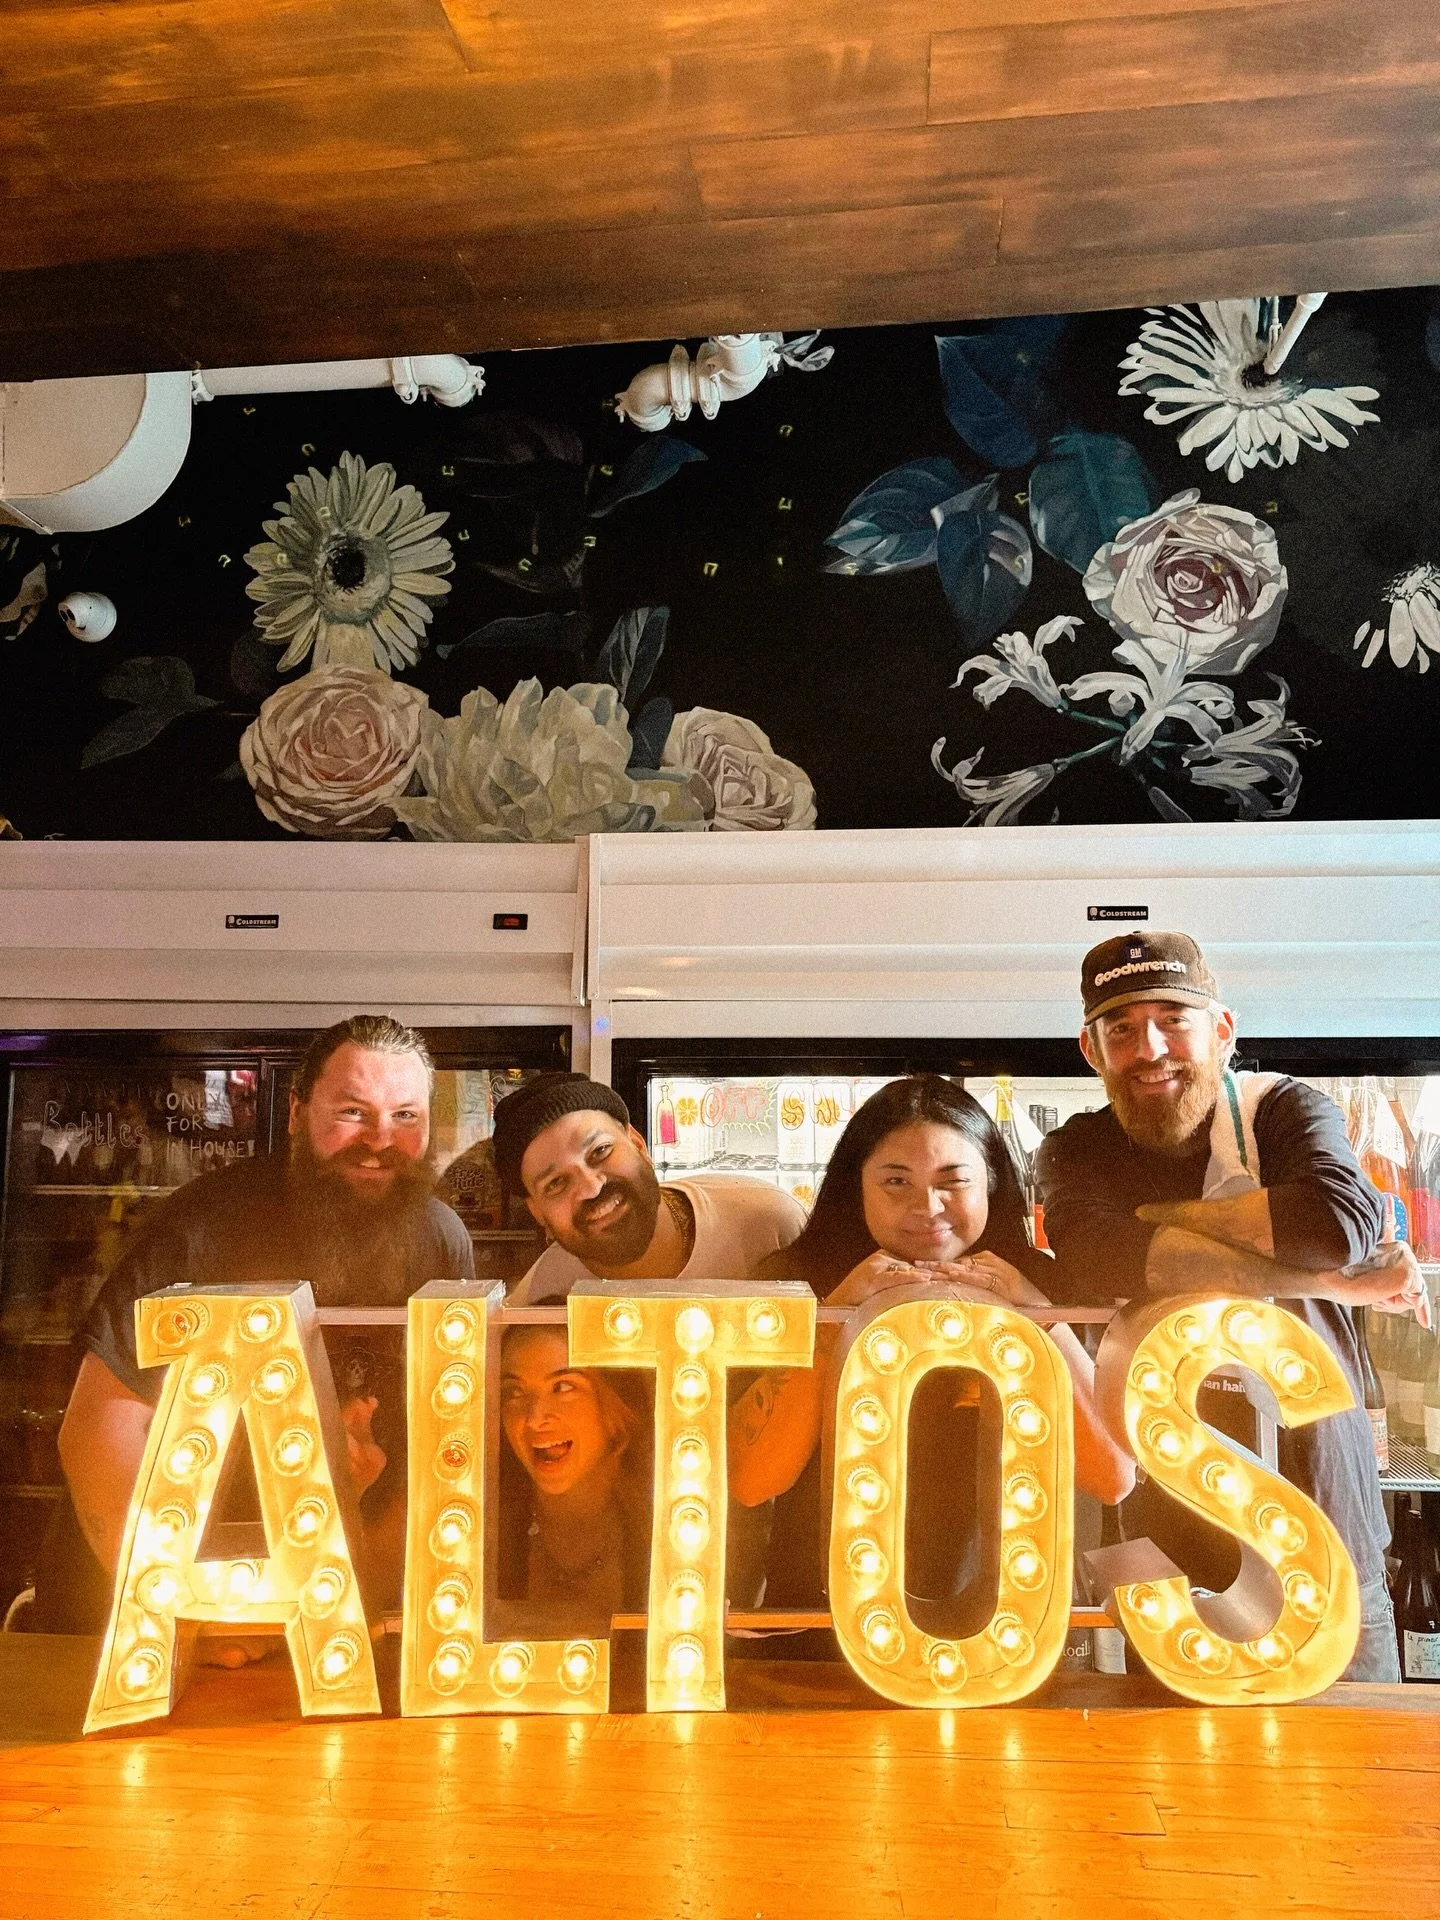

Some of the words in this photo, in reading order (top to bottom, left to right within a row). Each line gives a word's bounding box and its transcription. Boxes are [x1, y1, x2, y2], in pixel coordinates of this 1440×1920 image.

[1130, 948, 1142, 958] GM
[1095, 960, 1187, 986] Goodwrench
[39, 1100, 150, 1149] Bottles
[165, 1113, 203, 1133] FOR
[84, 1284, 1361, 1736] ALTOS
